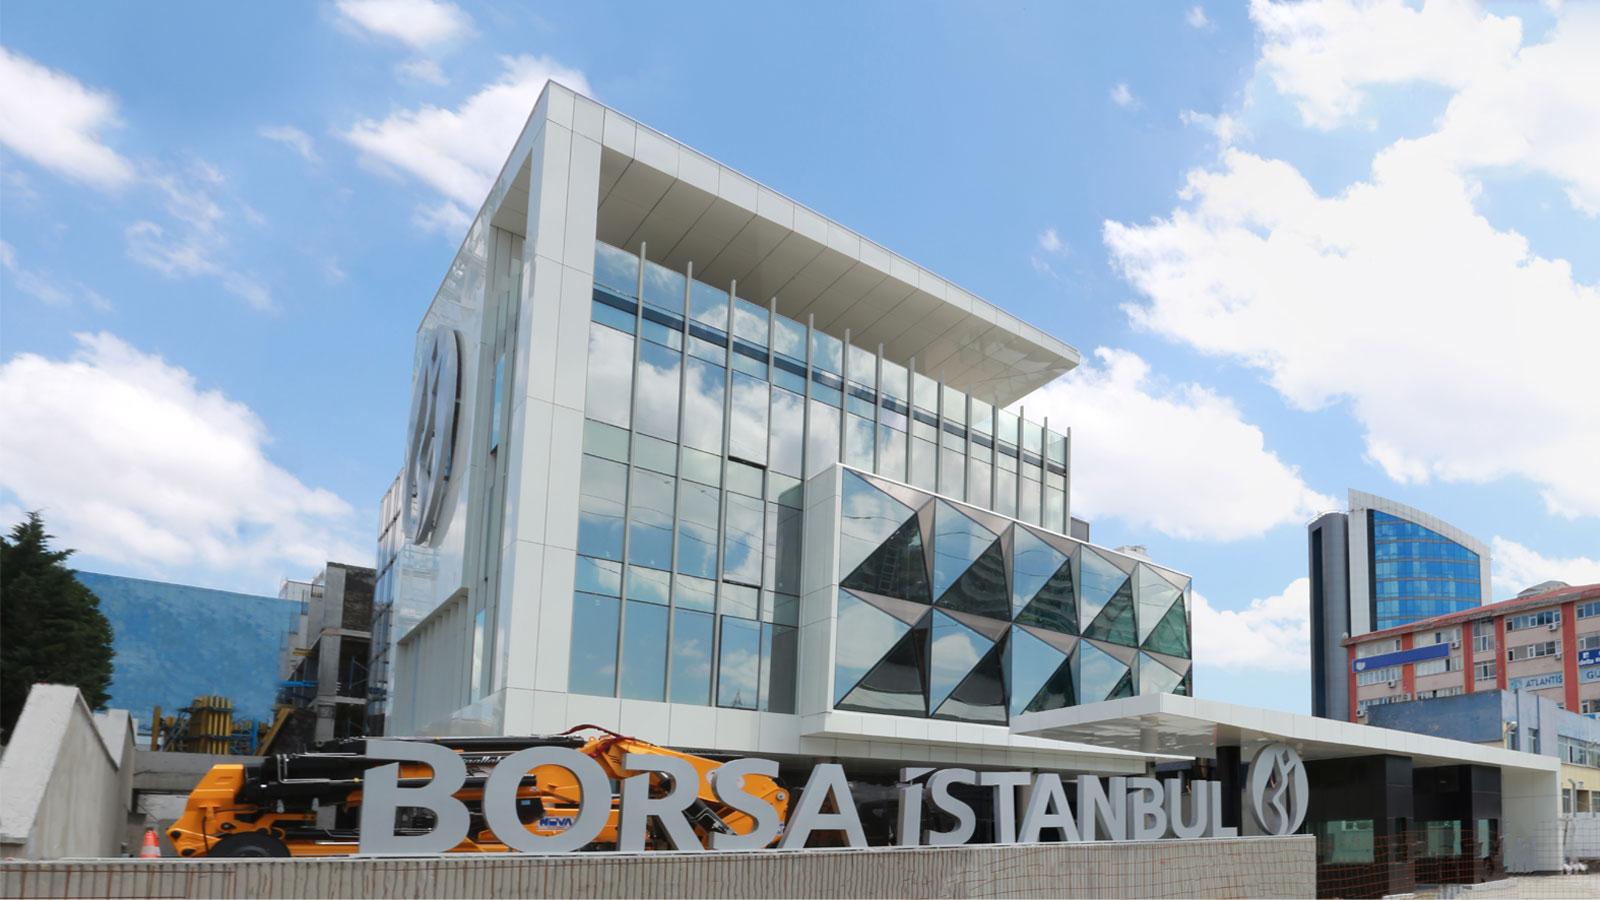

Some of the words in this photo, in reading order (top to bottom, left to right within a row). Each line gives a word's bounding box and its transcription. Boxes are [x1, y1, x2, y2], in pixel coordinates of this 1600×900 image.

[1525, 674, 1563, 688] ATLANTIS
[360, 741, 867, 853] BORSA
[539, 817, 572, 827] NOVA
